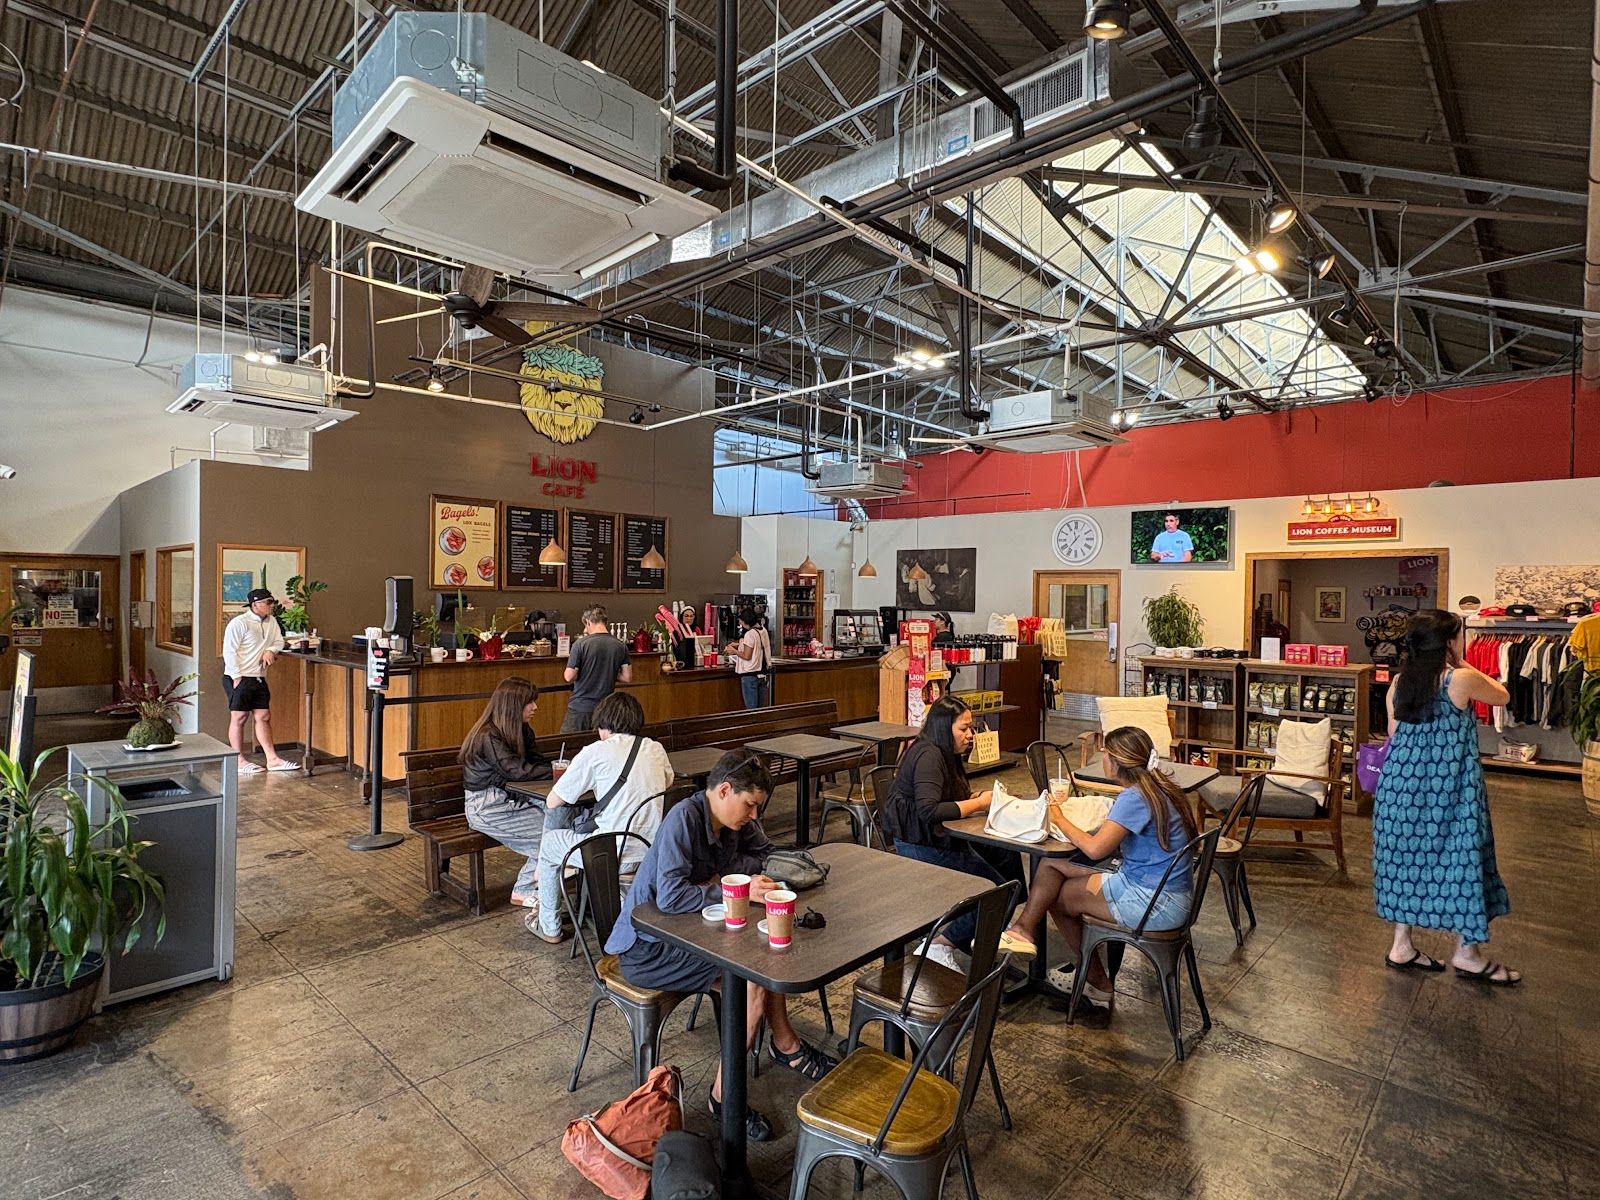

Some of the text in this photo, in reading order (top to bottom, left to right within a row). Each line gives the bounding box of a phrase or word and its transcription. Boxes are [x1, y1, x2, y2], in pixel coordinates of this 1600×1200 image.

[529, 452, 597, 484] LION
[440, 505, 480, 522] Bagels!
[1315, 527, 1349, 535] COFFEE
[1408, 557, 1434, 568] LION
[45, 610, 61, 620] NO
[908, 673, 925, 681] LION
[1505, 748, 1527, 758] LION
[1366, 764, 1381, 774] DEA
[768, 906, 788, 916] LION
